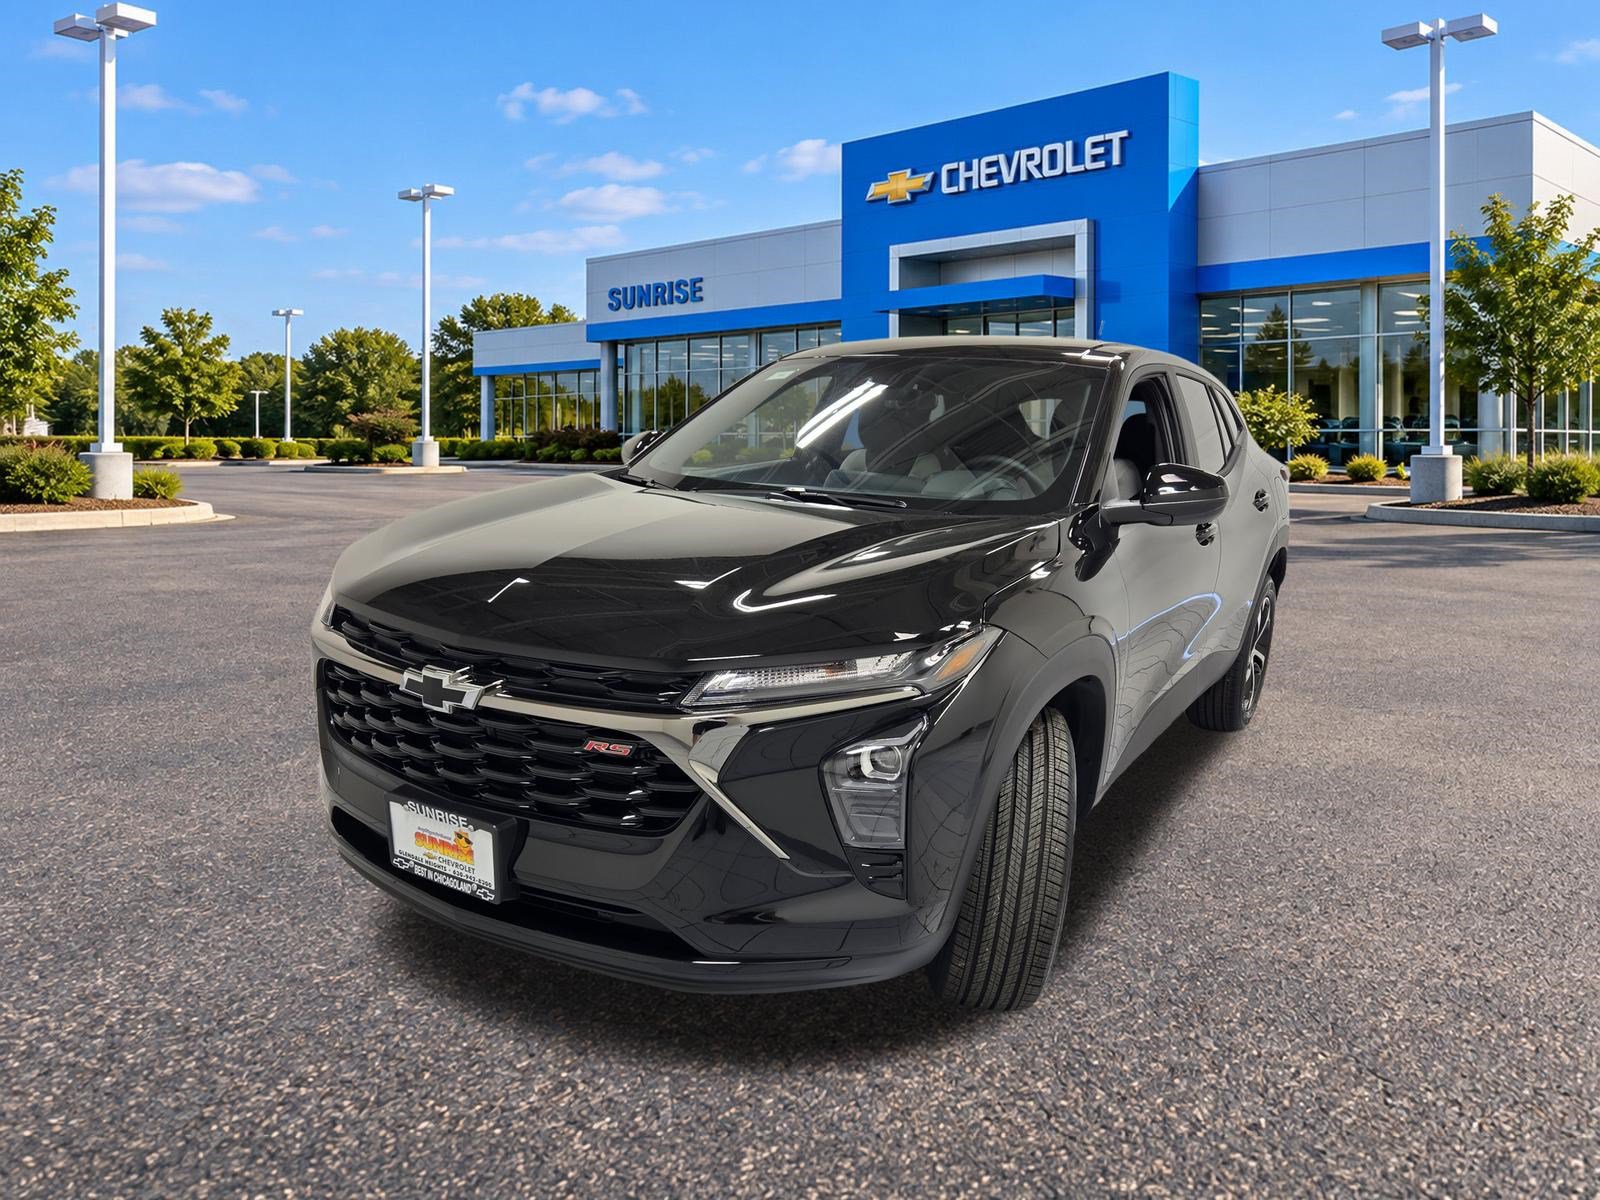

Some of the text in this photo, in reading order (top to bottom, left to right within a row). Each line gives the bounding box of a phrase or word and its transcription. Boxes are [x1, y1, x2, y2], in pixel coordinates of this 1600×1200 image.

[940, 129, 1130, 194] CHEVROLET
[608, 277, 704, 312] SUNRISE
[583, 740, 633, 756] RS
[407, 801, 468, 828] SUNRISE
[414, 864, 472, 894] BEST IN CHICAGOLAND
[438, 856, 476, 875] CHEVROLET
